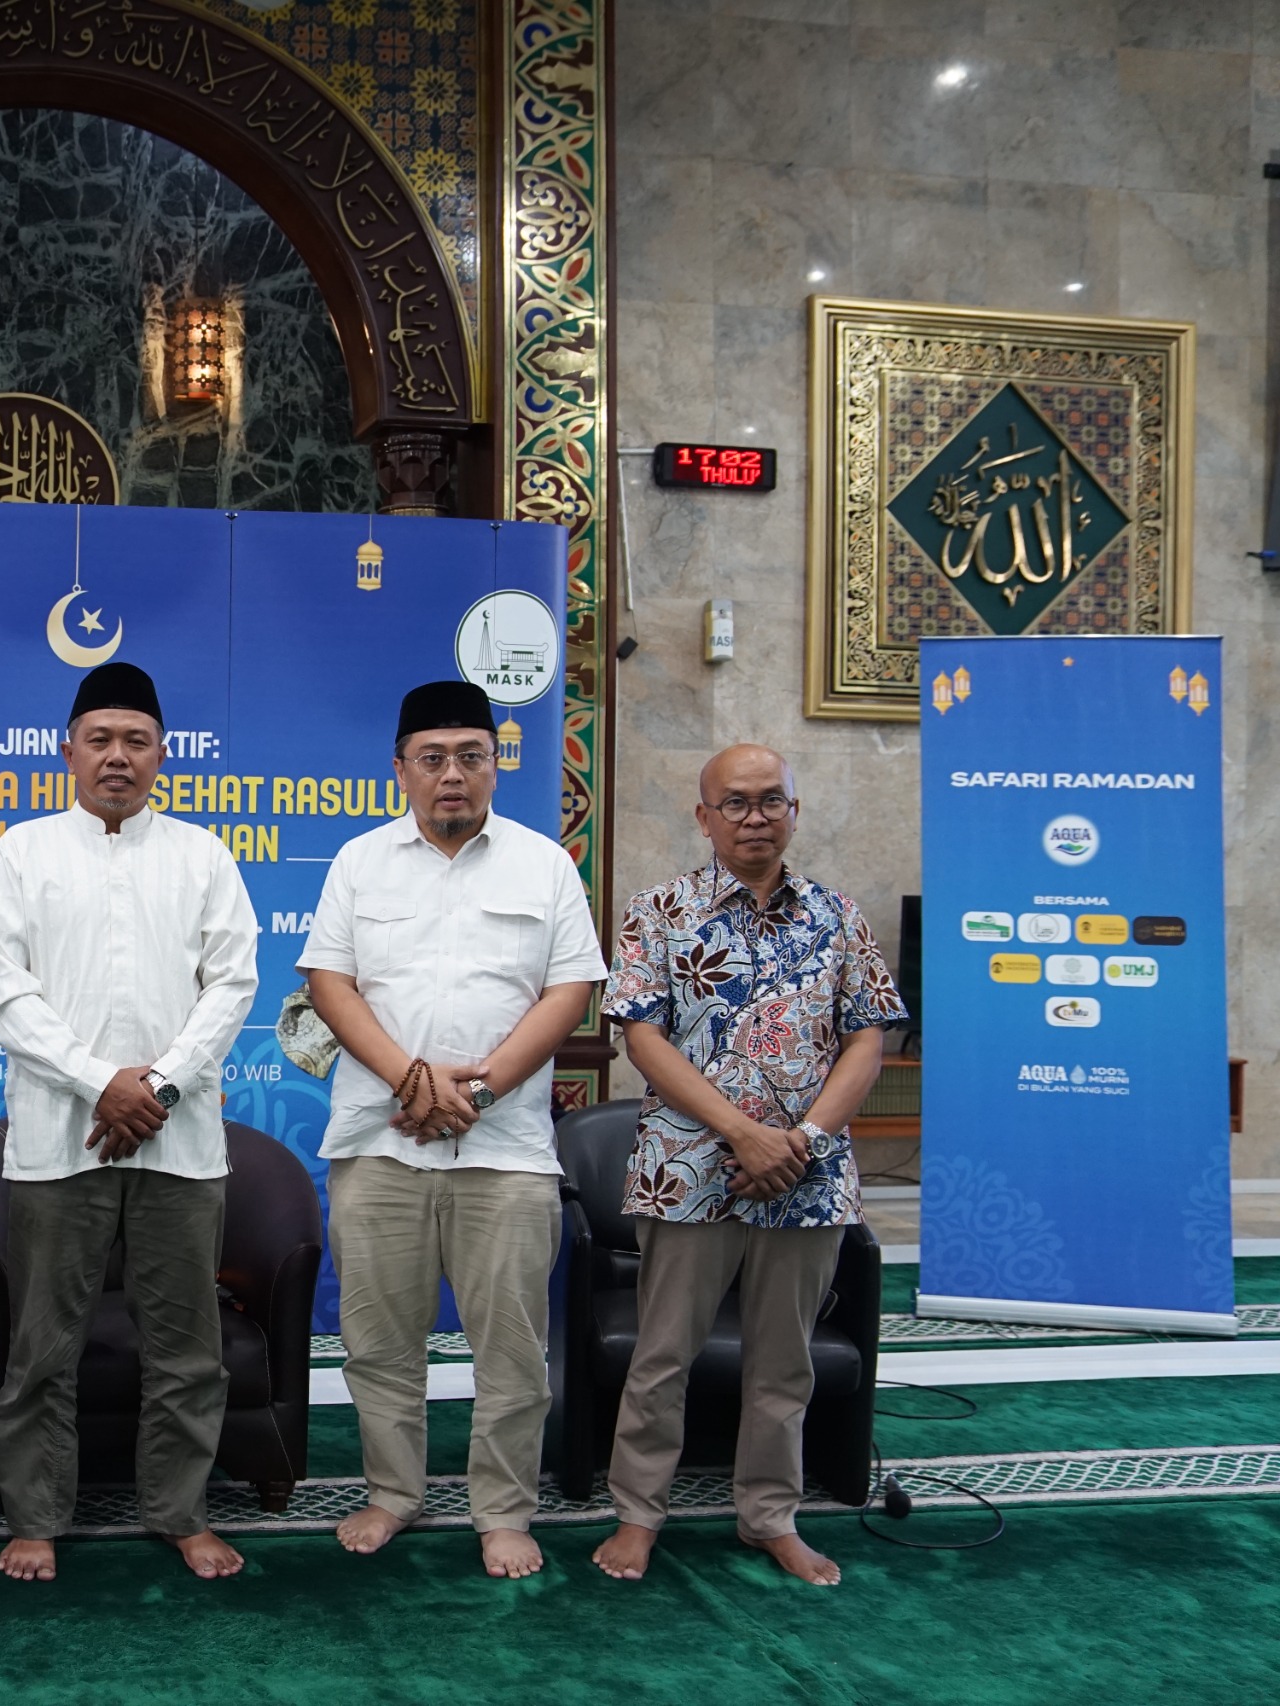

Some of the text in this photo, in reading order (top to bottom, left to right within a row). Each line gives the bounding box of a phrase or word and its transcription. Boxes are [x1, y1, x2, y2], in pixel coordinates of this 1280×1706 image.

[486, 672, 534, 687] MASK
[950, 771, 1195, 790] SAFARI RAMADAN
[147, 774, 264, 814] SEHAT
[1050, 827, 1091, 843] AQUA
[1033, 895, 1109, 906] BERSAMA
[1123, 964, 1156, 977] UMJ
[244, 1064, 281, 1081] WIB
[1018, 1064, 1068, 1084] AQUA
[1091, 1067, 1127, 1076] 100%
[1088, 1076, 1130, 1084] MURNI
